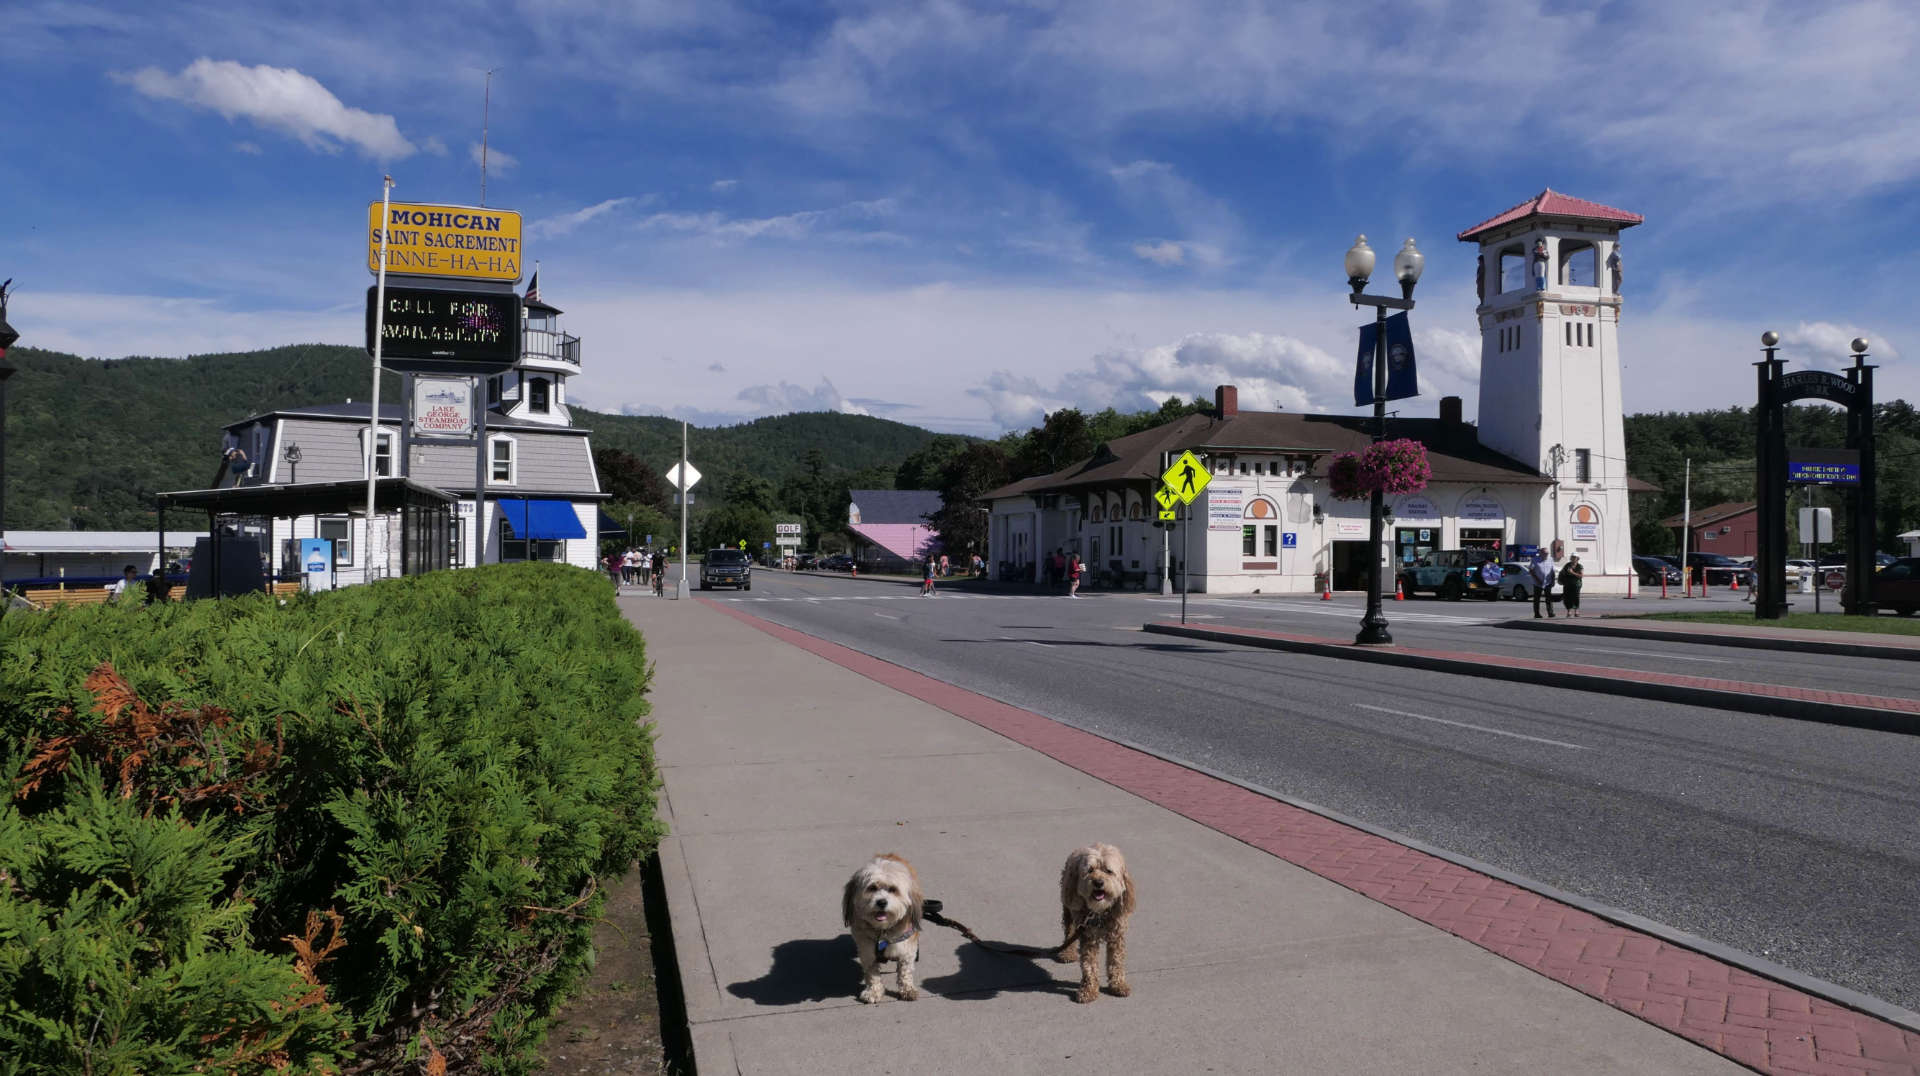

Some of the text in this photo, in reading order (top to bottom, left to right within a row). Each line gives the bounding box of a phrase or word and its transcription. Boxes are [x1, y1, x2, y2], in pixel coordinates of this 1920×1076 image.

[391, 210, 501, 231] MOHICAN
[372, 229, 518, 253] SAINT SACREMENT
[372, 249, 517, 273] MINNE-HA-HA
[390, 299, 488, 317] CALL FOR
[1830, 375, 1856, 394] WOOD
[418, 416, 468, 425] STEAMBOAT
[426, 411, 460, 419] GEORGE
[423, 422, 463, 430] COMPANY
[777, 525, 799, 533] GOLF
